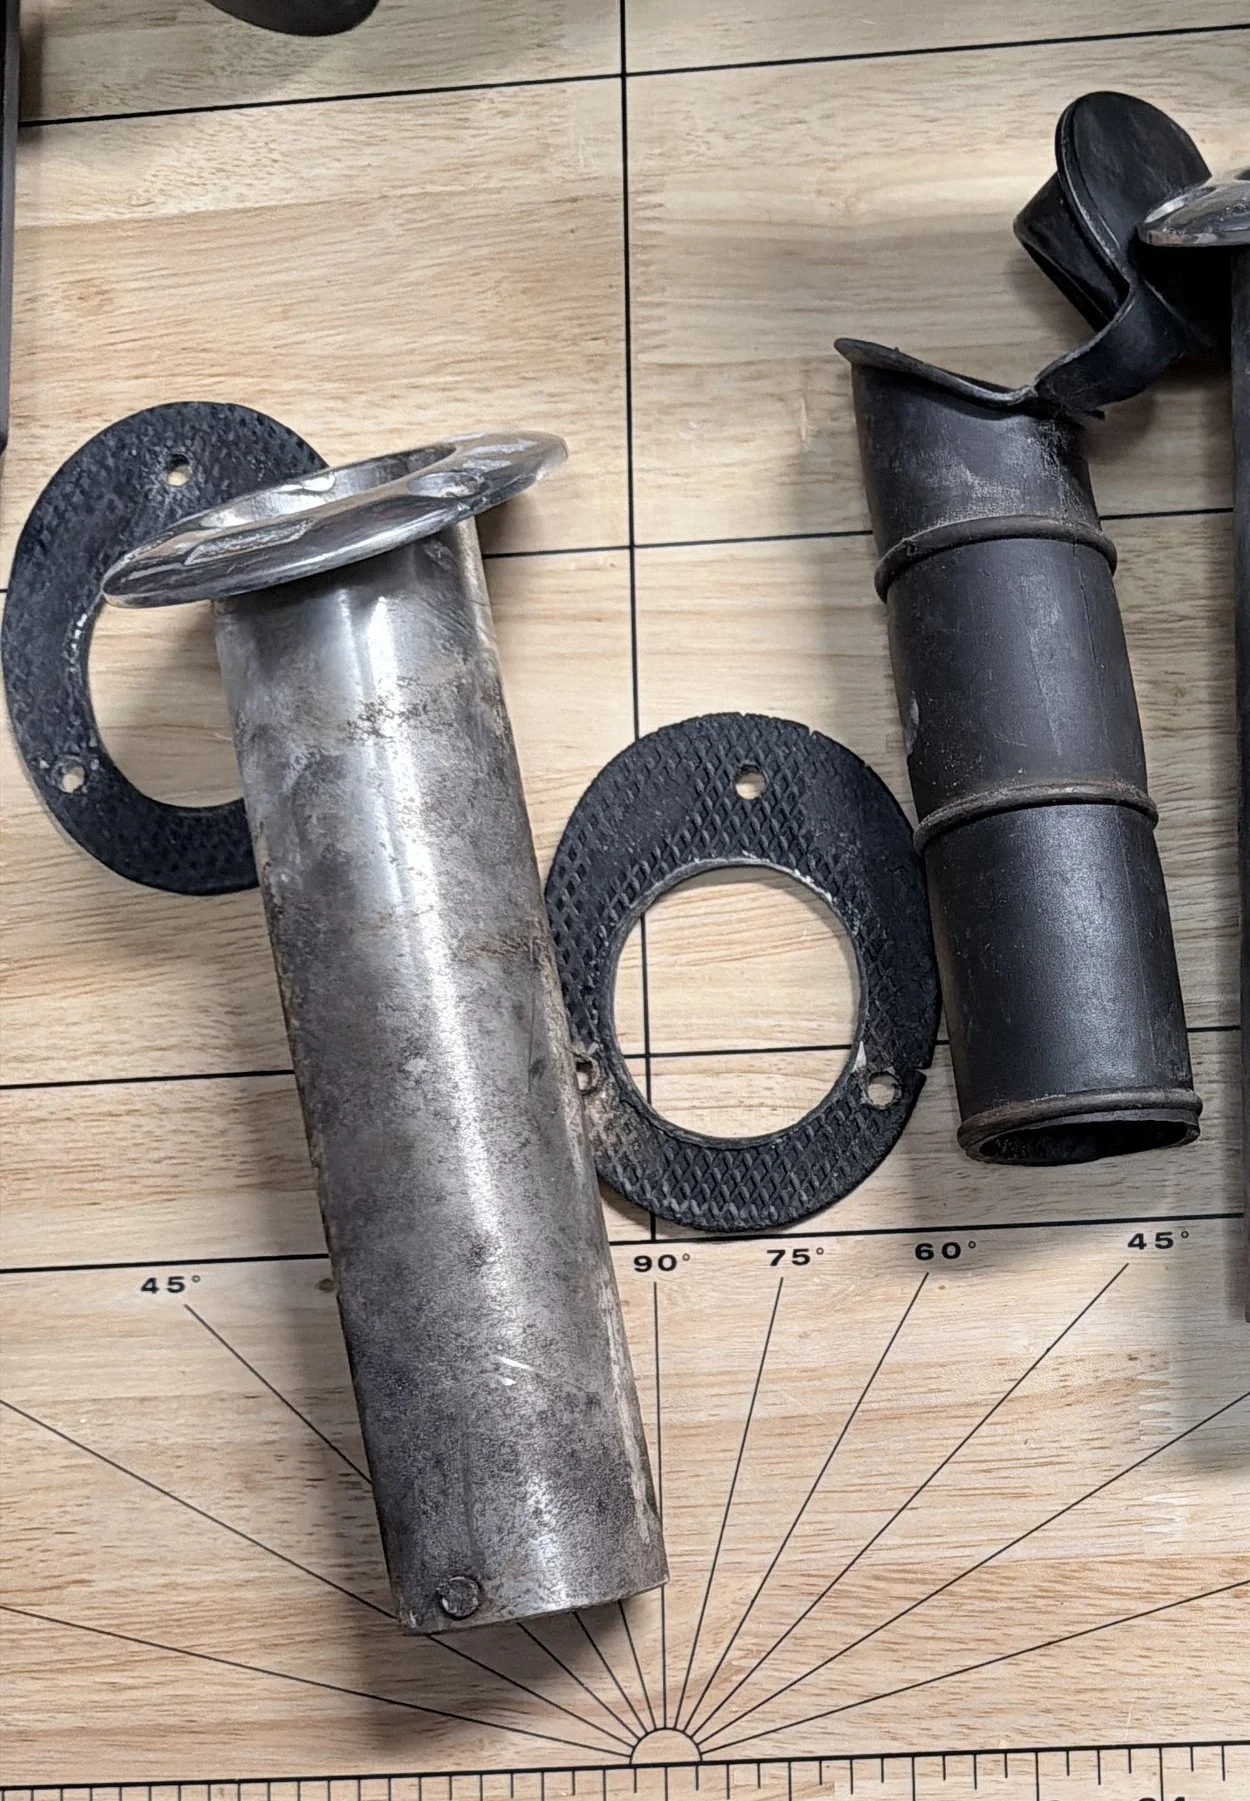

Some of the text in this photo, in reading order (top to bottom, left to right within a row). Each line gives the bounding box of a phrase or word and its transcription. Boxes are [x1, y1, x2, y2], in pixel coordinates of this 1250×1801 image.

[914, 1240, 977, 1262] 60°
[1127, 1230, 1190, 1251] 45°
[633, 1253, 691, 1273] 90°
[766, 1247, 825, 1268] 75°
[140, 1274, 201, 1294] 45°
